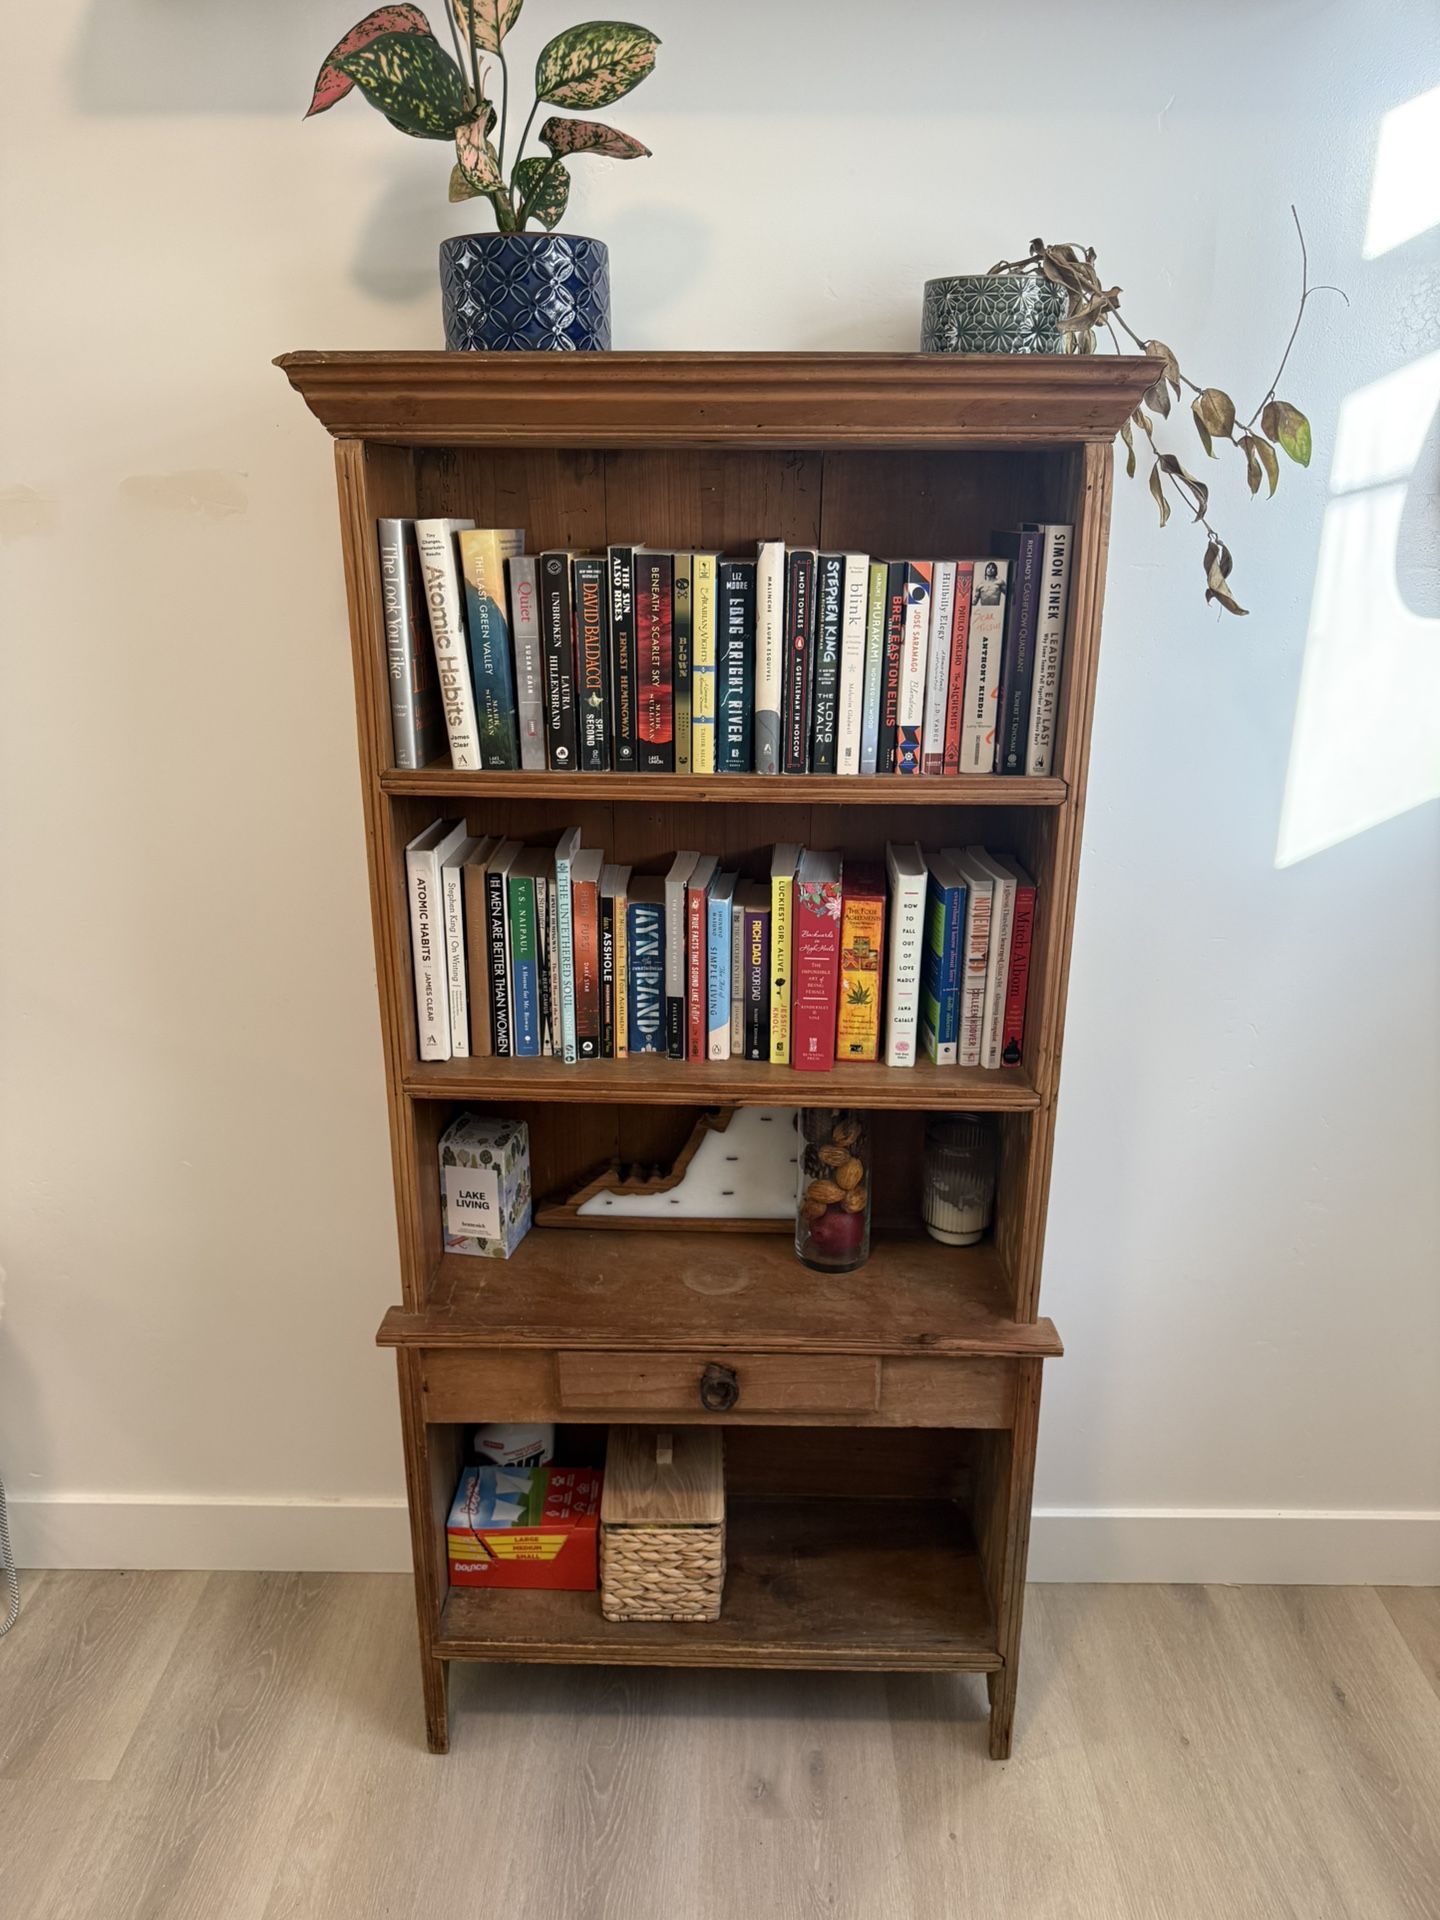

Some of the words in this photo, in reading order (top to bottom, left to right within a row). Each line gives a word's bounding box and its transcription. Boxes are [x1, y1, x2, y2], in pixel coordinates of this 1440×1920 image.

[382, 543, 398, 574] The
[474, 556, 484, 574] THE
[1026, 539, 1034, 558] RICH
[1051, 534, 1065, 577] SIMON
[613, 556, 622, 587] ALSO
[622, 565, 630, 590] THE
[726, 582, 748, 590] MOORE
[732, 573, 742, 581] LIZ
[875, 572, 883, 597] HARUKI
[384, 577, 402, 613] Look
[476, 578, 487, 602] LAST
[517, 581, 532, 623] Quiet
[582, 583, 600, 623] DAVID
[614, 589, 623, 621] RISES
[622, 592, 631, 614] SUN
[651, 567, 660, 611] BENEATH
[825, 561, 840, 621] STEPHEN
[848, 583, 863, 626] blink
[939, 572, 951, 612] Hillbilly
[1020, 583, 1031, 628] CASHFLOW
[1047, 583, 1062, 620] SINEK
[386, 615, 402, 645] You
[478, 605, 490, 638] GREEN
[551, 592, 562, 648] UNBROKEN
[651, 615, 660, 623] A
[729, 598, 745, 635] LONG
[892, 596, 903, 631] BRET
[912, 609, 922, 629] JOSÉ
[937, 614, 948, 641] Elegy
[956, 605, 965, 632] PAULO
[426, 565, 453, 649] Atomic
[440, 657, 464, 727] Habits
[651, 626, 660, 666] SCARLET
[822, 626, 839, 663] KING
[870, 601, 882, 663] MURAKAMI
[390, 648, 405, 679] Like
[482, 641, 494, 675] VALLEY
[524, 644, 532, 672] SUSAN
[584, 628, 601, 689] BALDACCI
[619, 632, 628, 671] ERNEST
[888, 635, 901, 688] EASTON
[910, 631, 920, 673] SARAMAGO
[954, 634, 964, 666] COELHO
[979, 636, 988, 683] ANTHONY
[1016, 629, 1028, 673] QUADRANT
[1045, 632, 1059, 688] LEADERS
[650, 670, 660, 687] SKY
[728, 641, 744, 693] BRIGHT
[526, 674, 534, 694] CAIN
[549, 655, 561, 730] HILLENBRAND
[560, 675, 570, 710] LAURA
[794, 665, 802, 710] GENTLEMAN
[619, 675, 630, 739] HEMINGWAY
[648, 693, 656, 740] SULLIVAN
[794, 713, 801, 721] IN
[886, 691, 897, 727] ELLIS
[976, 685, 985, 719] KIEDIS
[1043, 692, 1054, 713] EAT
[585, 714, 595, 746] SECOND
[594, 718, 603, 742] SPLIT
[727, 700, 743, 742] RIVER
[816, 701, 825, 743] WALK
[824, 702, 833, 743] LONG
[1040, 718, 1052, 747] LAST
[417, 878, 429, 920] ATOMIC
[447, 882, 457, 914] Stephen
[490, 891, 504, 916] MEN
[559, 876, 569, 901] THE
[777, 881, 785, 922] LUCKIEST
[448, 915, 458, 933] King
[492, 918, 505, 939] ARE
[538, 896, 546, 930] Stranger
[691, 913, 699, 929] TRUE
[970, 897, 989, 954] NOVEMBER
[420, 923, 431, 961] HABITS
[450, 941, 459, 953] On
[519, 910, 528, 953] NAIPAUL
[559, 903, 571, 978] UNTETHERED
[635, 909, 659, 956] AYN
[752, 920, 762, 943] RICH
[777, 925, 785, 946] GIRL
[1014, 911, 1031, 950] Mitch
[450, 955, 461, 982] Writing
[493, 941, 507, 976] BETTER
[583, 962, 591, 978] DARK
[603, 932, 611, 982] ASSHOLE
[710, 947, 718, 979] SIMPLE
[752, 944, 762, 965] DAD
[777, 948, 785, 973] ALIVE
[424, 972, 432, 996] JAMES
[752, 967, 761, 985] POOR
[1010, 952, 1026, 998] Albom
[495, 978, 508, 1007] THAN
[563, 980, 572, 1009] SOUL
[636, 972, 660, 1033] RAND
[710, 983, 718, 1016] LIVING
[752, 986, 761, 1001] DAD
[426, 998, 434, 1022] CLEAR
[772, 1007, 780, 1035] KNOLL
[780, 1003, 788, 1039] JESSICA
[496, 1009, 510, 1053] WOMEN
[456, 1200, 490, 1210] LIVING
[459, 1190, 486, 1201] LAKE
[454, 1562, 488, 1572] bounce
